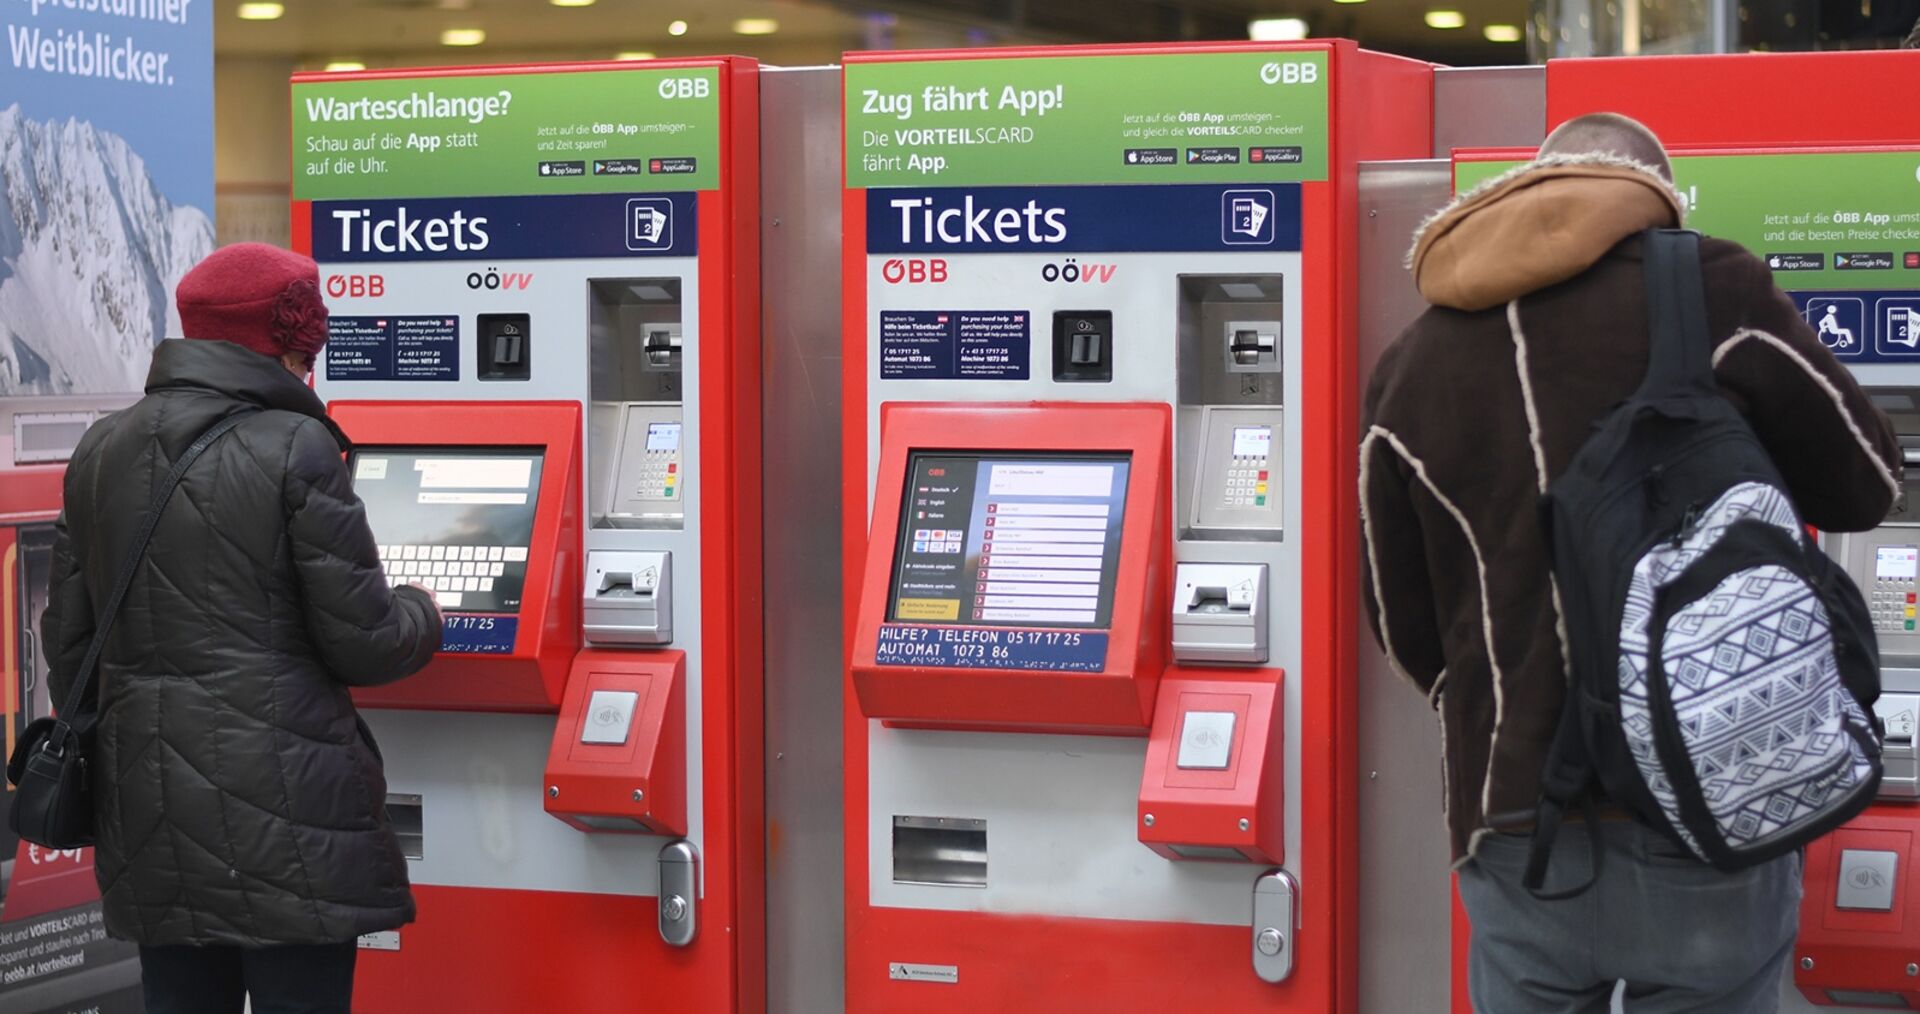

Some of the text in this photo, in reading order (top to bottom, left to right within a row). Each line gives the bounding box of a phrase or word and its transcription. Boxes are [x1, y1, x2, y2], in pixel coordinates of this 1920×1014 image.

[8, 24, 174, 86] Weitblicker.
[1260, 61, 1318, 85] ÖBB
[658, 77, 710, 99] ÖBB
[305, 90, 512, 124] Warteschlange?
[862, 84, 1064, 120] Zug fährt App!
[1122, 111, 1272, 124] Jetzt auf die ÖBB App umsteigen
[537, 122, 687, 137] Jetzt auf die ÖBB App umsteigen
[863, 127, 1034, 147] Die VORTEILSCARD
[1123, 125, 1304, 139] und gleich die VORTEILSCARD checken!
[306, 132, 478, 153] Schau auf die App statt
[537, 139, 607, 152] und Zeit sparen!
[863, 153, 949, 175] fährt App.
[1140, 155, 1152, 163] App
[1201, 154, 1237, 162] Google Play
[1264, 153, 1299, 161] AppGallery
[306, 156, 388, 175] auf die Uhr.
[552, 167, 565, 175] App
[606, 165, 624, 173] Google
[627, 164, 639, 173] Play
[662, 163, 694, 172] AppGallery
[890, 195, 1067, 244] Tickets
[1763, 214, 1788, 225] Jetzt
[1792, 212, 1809, 224] auf
[1813, 212, 1829, 224] die
[1833, 209, 1860, 224] ÖBB
[1864, 212, 1890, 225] App
[333, 207, 489, 253] Tickets
[1763, 230, 1785, 241] und
[1788, 229, 1805, 241] die
[1808, 229, 1844, 240] besten
[1848, 228, 1879, 240] Preise
[882, 258, 948, 284] ÖBB
[1783, 260, 1819, 269] App Store
[1850, 259, 1891, 268] Google Play
[327, 274, 385, 298] ÖBB
[960, 323, 990, 331] purchasing
[996, 315, 1010, 323] help
[447, 617, 495, 630] 17 17 25
[879, 628, 1081, 646] HILFE? TELEFON 05 17 17 25
[877, 642, 1009, 659] AUTOMAT 1073 86
[29, 913, 88, 938] VORTEILSCARD
